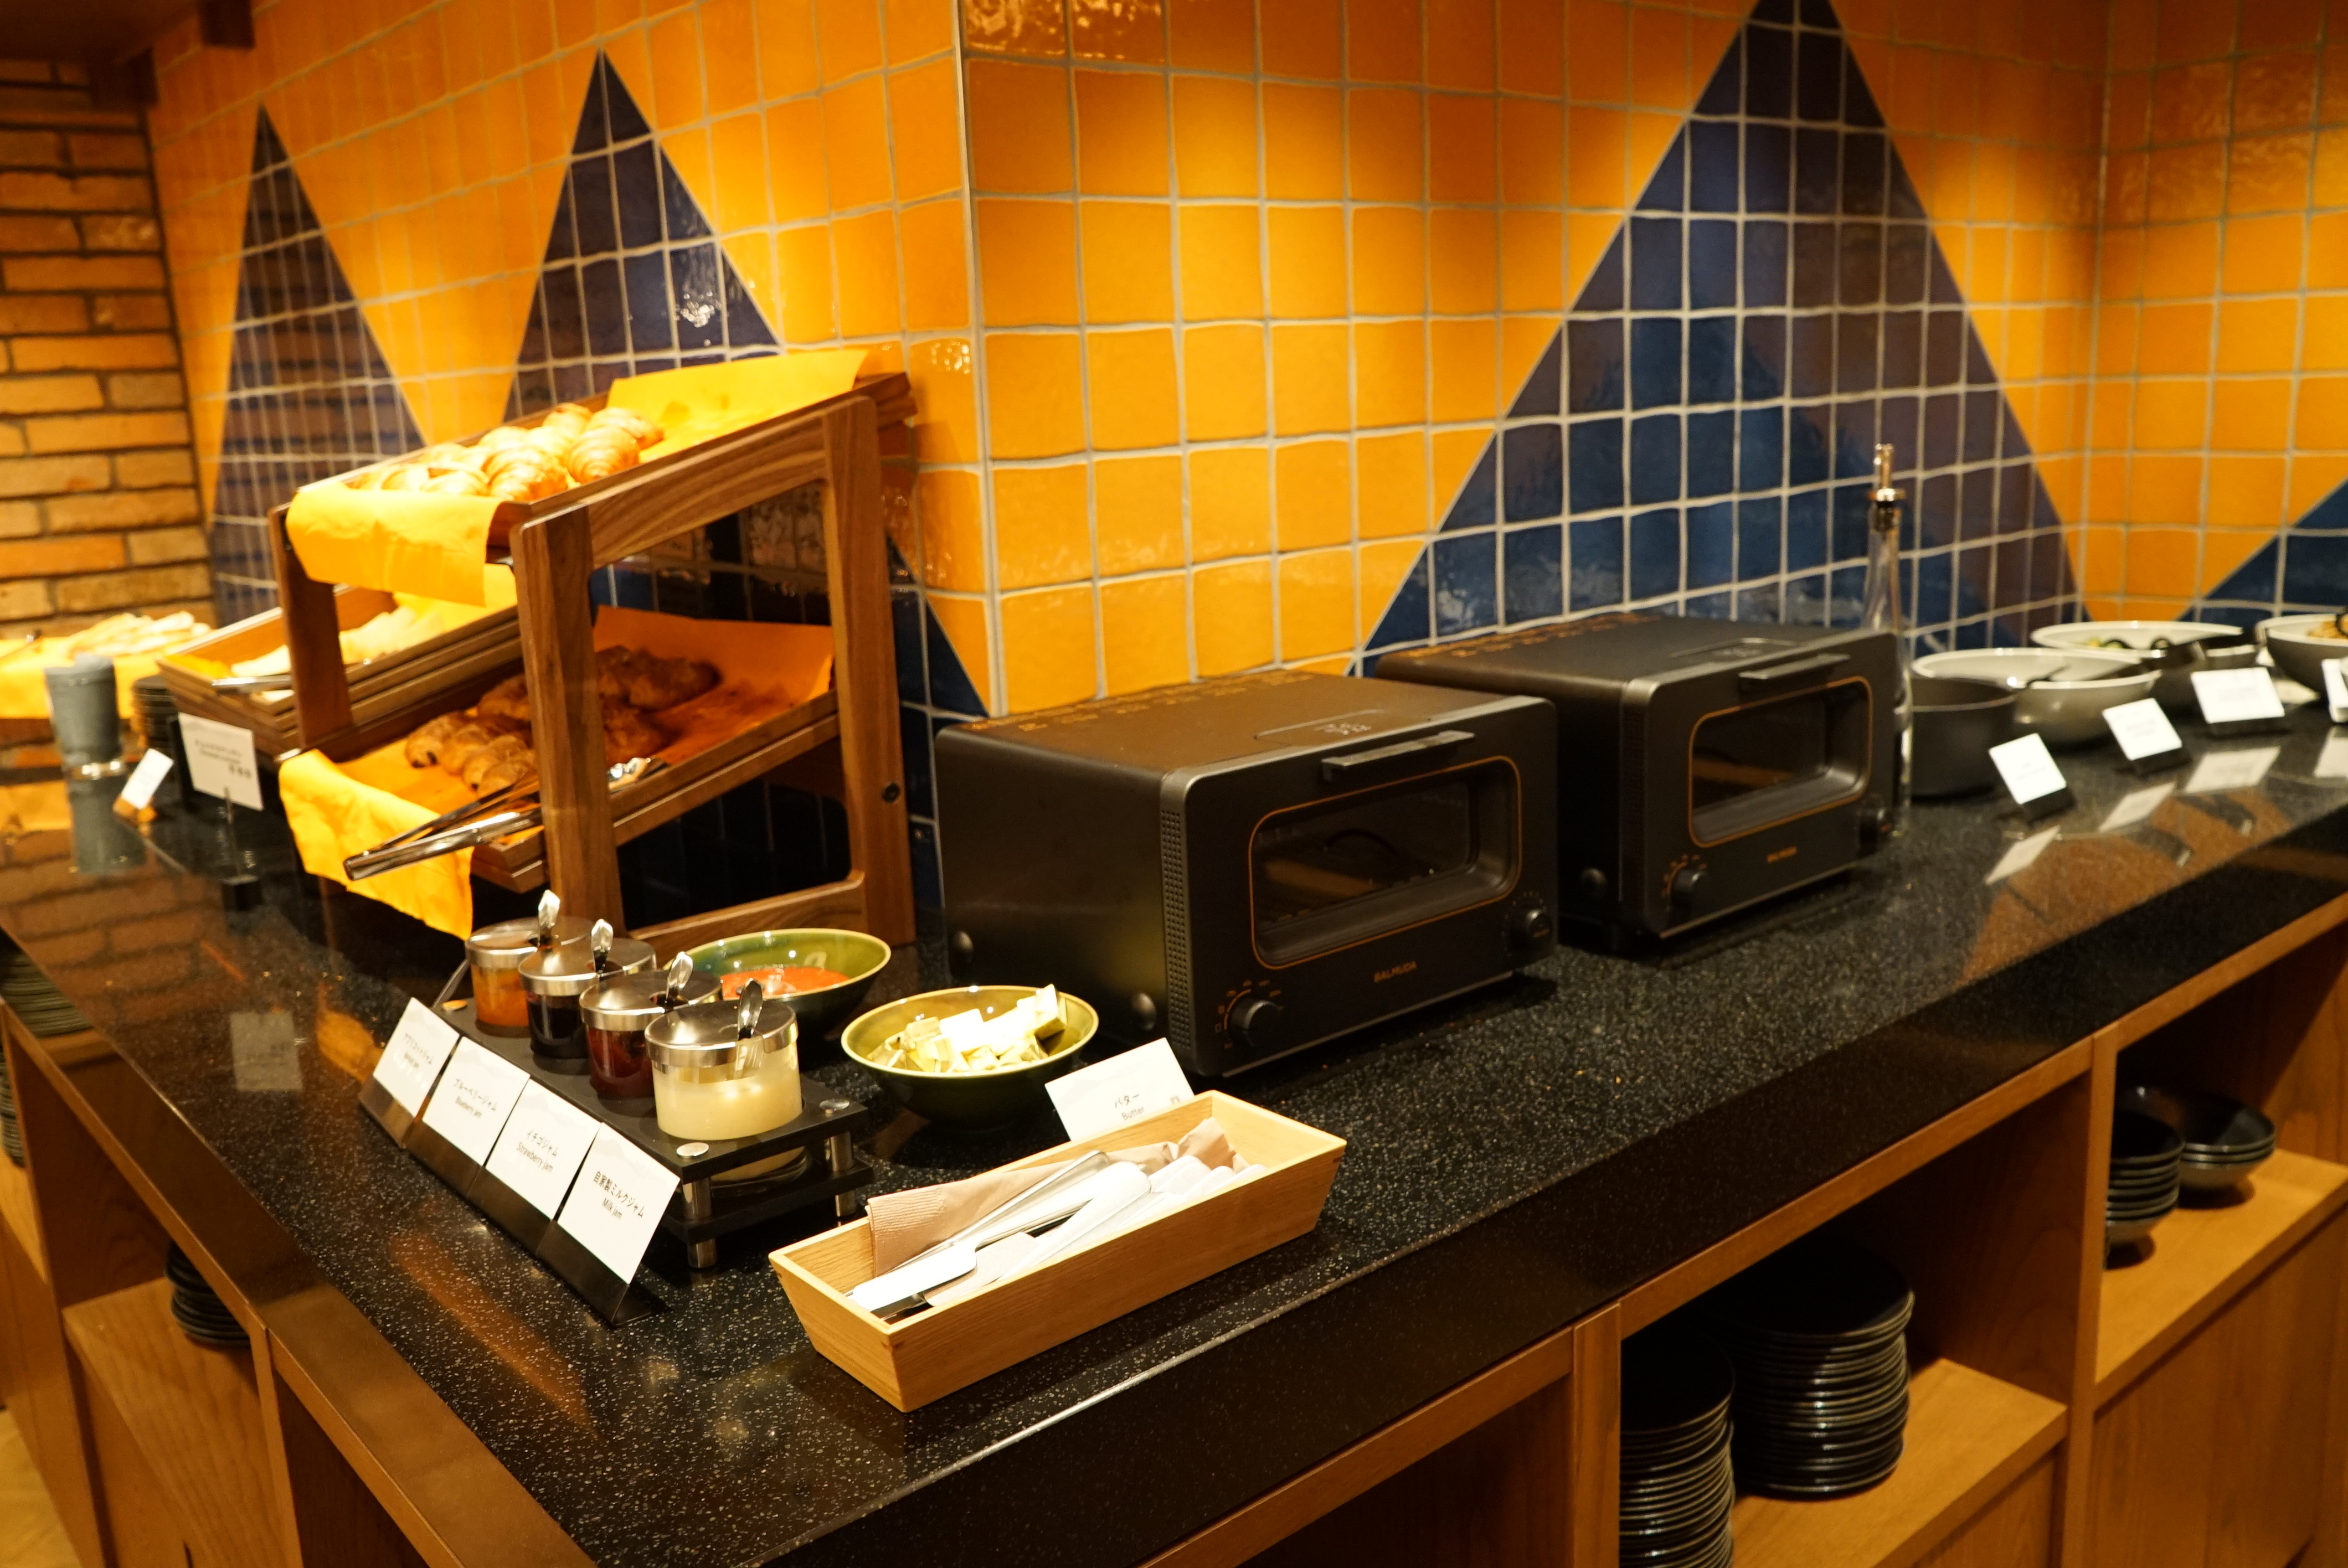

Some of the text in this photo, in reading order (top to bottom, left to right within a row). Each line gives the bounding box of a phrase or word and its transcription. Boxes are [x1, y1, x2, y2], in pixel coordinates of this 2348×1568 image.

[1115, 1094, 1140, 1108] バター
[1121, 1107, 1144, 1120] Butter
[527, 1129, 558, 1157] イチゴジャム
[517, 1141, 553, 1173] Strawberry jam
[593, 1170, 645, 1218] 自家製ミルクジャム
[602, 1197, 622, 1220] Milk jam
